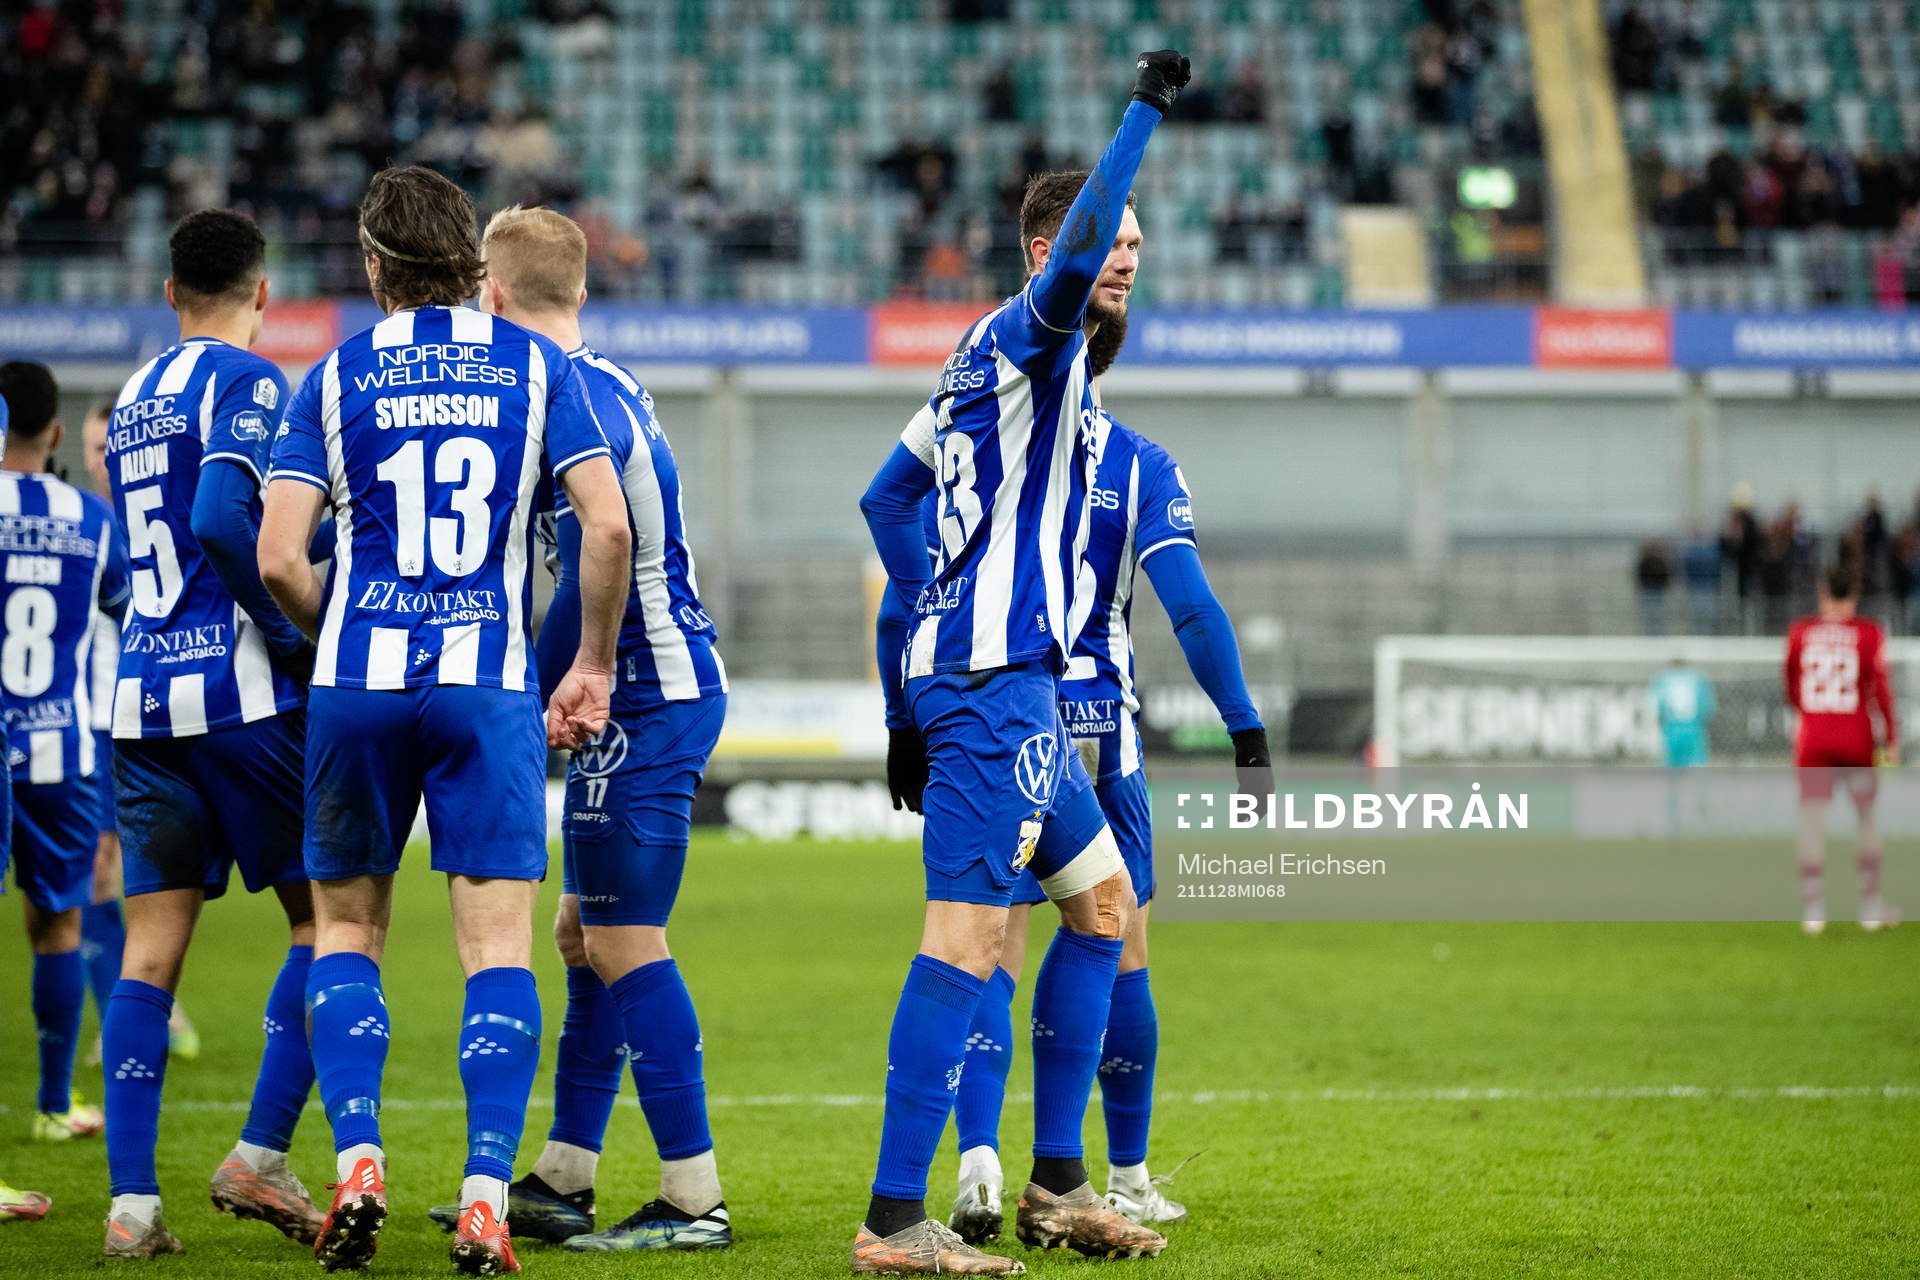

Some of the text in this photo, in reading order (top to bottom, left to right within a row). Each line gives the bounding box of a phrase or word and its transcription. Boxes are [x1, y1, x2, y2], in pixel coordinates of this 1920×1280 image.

[378, 344, 489, 368] NORDIC
[355, 363, 517, 392] WELLNESS
[113, 396, 176, 430] NORDIC
[375, 395, 499, 429] SVENSSON
[376, 436, 497, 578] 13
[125, 485, 184, 619] 5
[355, 581, 496, 613] El KONTAKT
[451, 608, 500, 623] INSTALCO
[1, 584, 58, 698] 8
[180, 645, 227, 663] INSTALCO
[1061, 699, 1115, 721] TAKT
[1072, 720, 1116, 734] INSTALCO
[586, 778, 609, 808] 17
[572, 811, 601, 822] CRAFT
